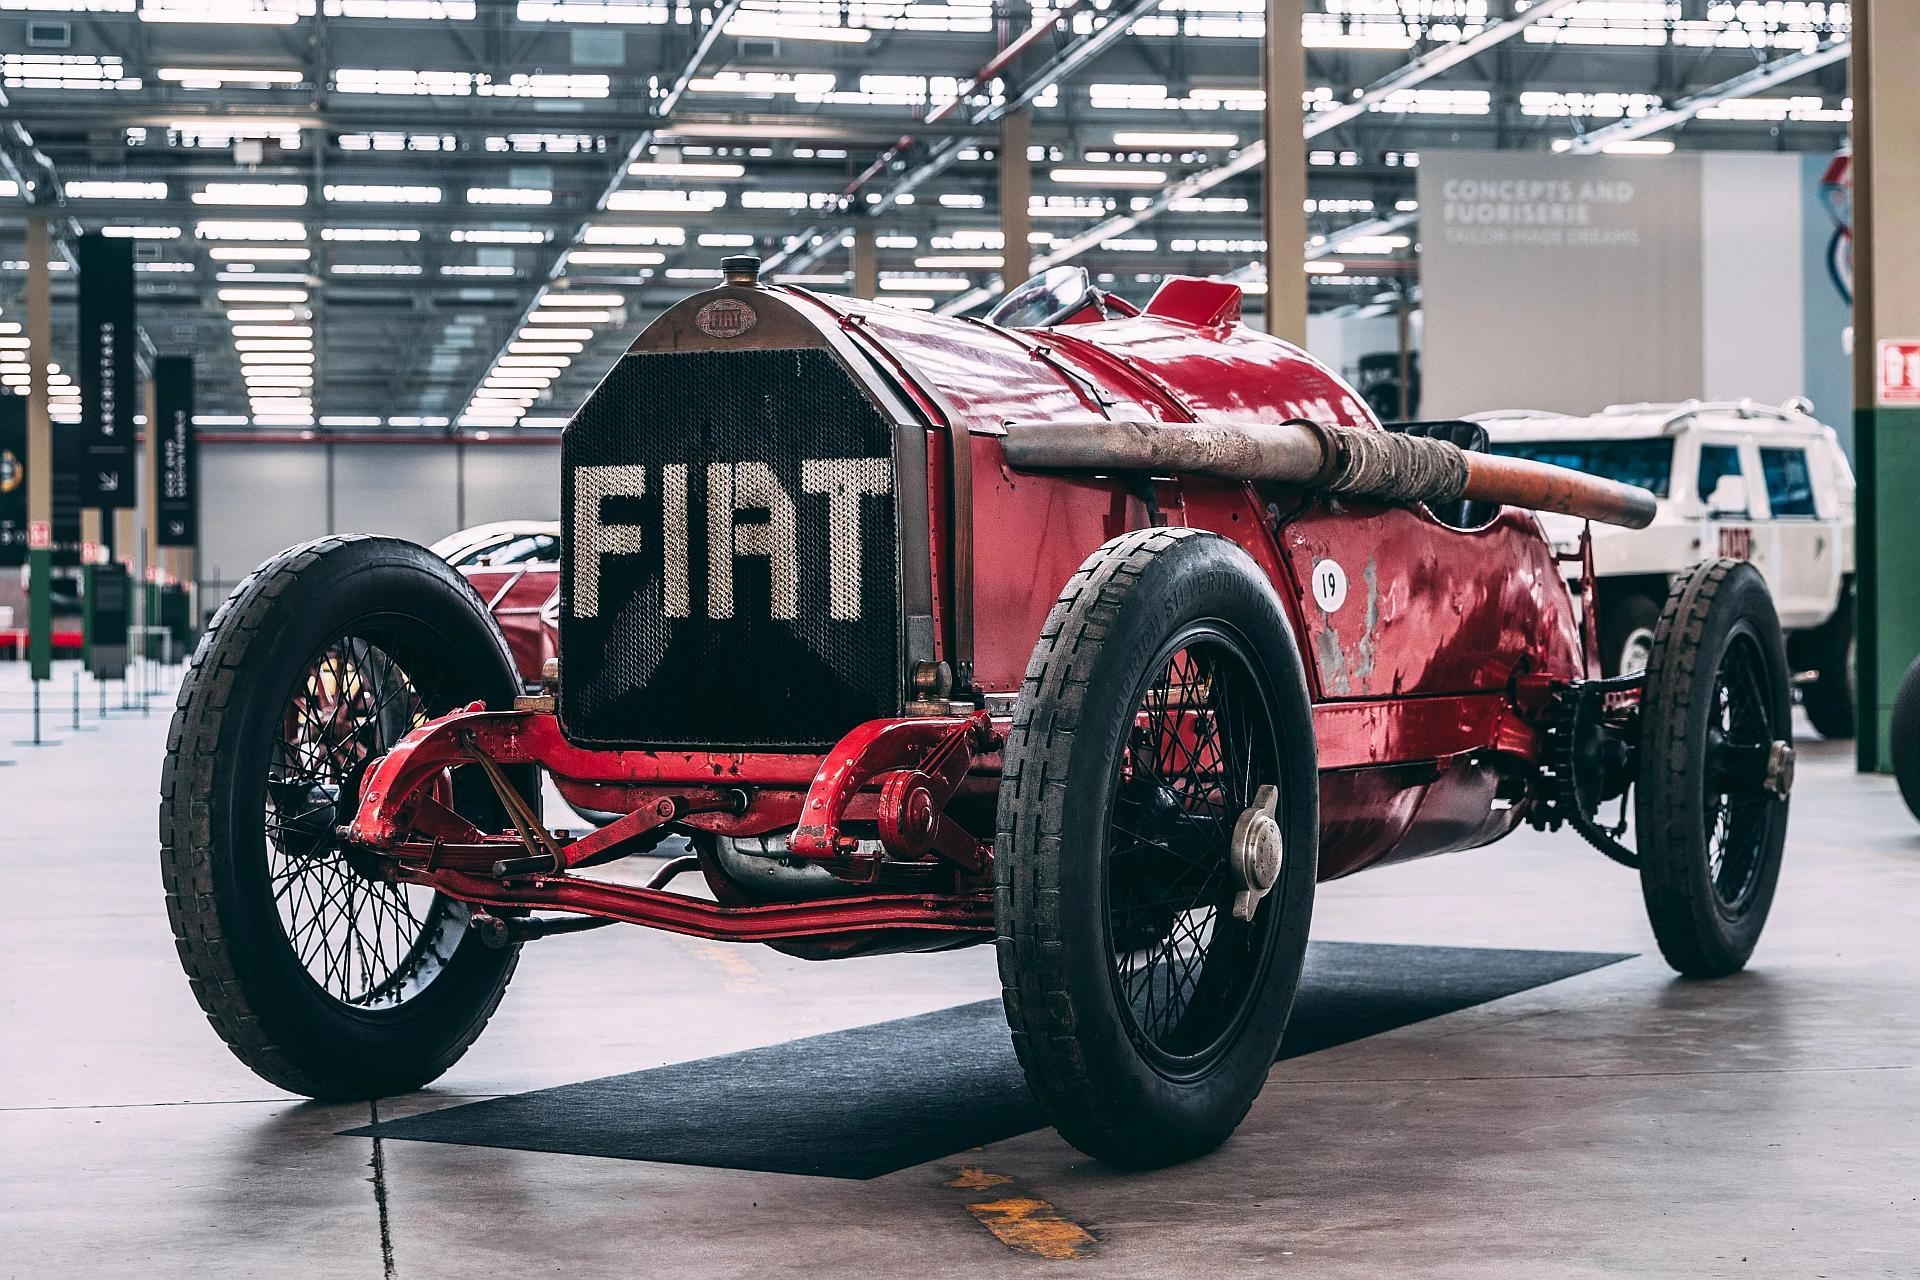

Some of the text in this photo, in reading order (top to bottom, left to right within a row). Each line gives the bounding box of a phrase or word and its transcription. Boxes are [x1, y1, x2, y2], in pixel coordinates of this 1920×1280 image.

[1443, 180, 1634, 202] CONCEPTS AND
[1443, 203, 1589, 225] FUORISERIE
[711, 310, 740, 328] FIAT
[100, 322, 116, 437] ARCHISTARS
[574, 457, 892, 621] FIAT
[1164, 569, 1256, 619] SILVERTOWN
[1321, 573, 1336, 598] 19
